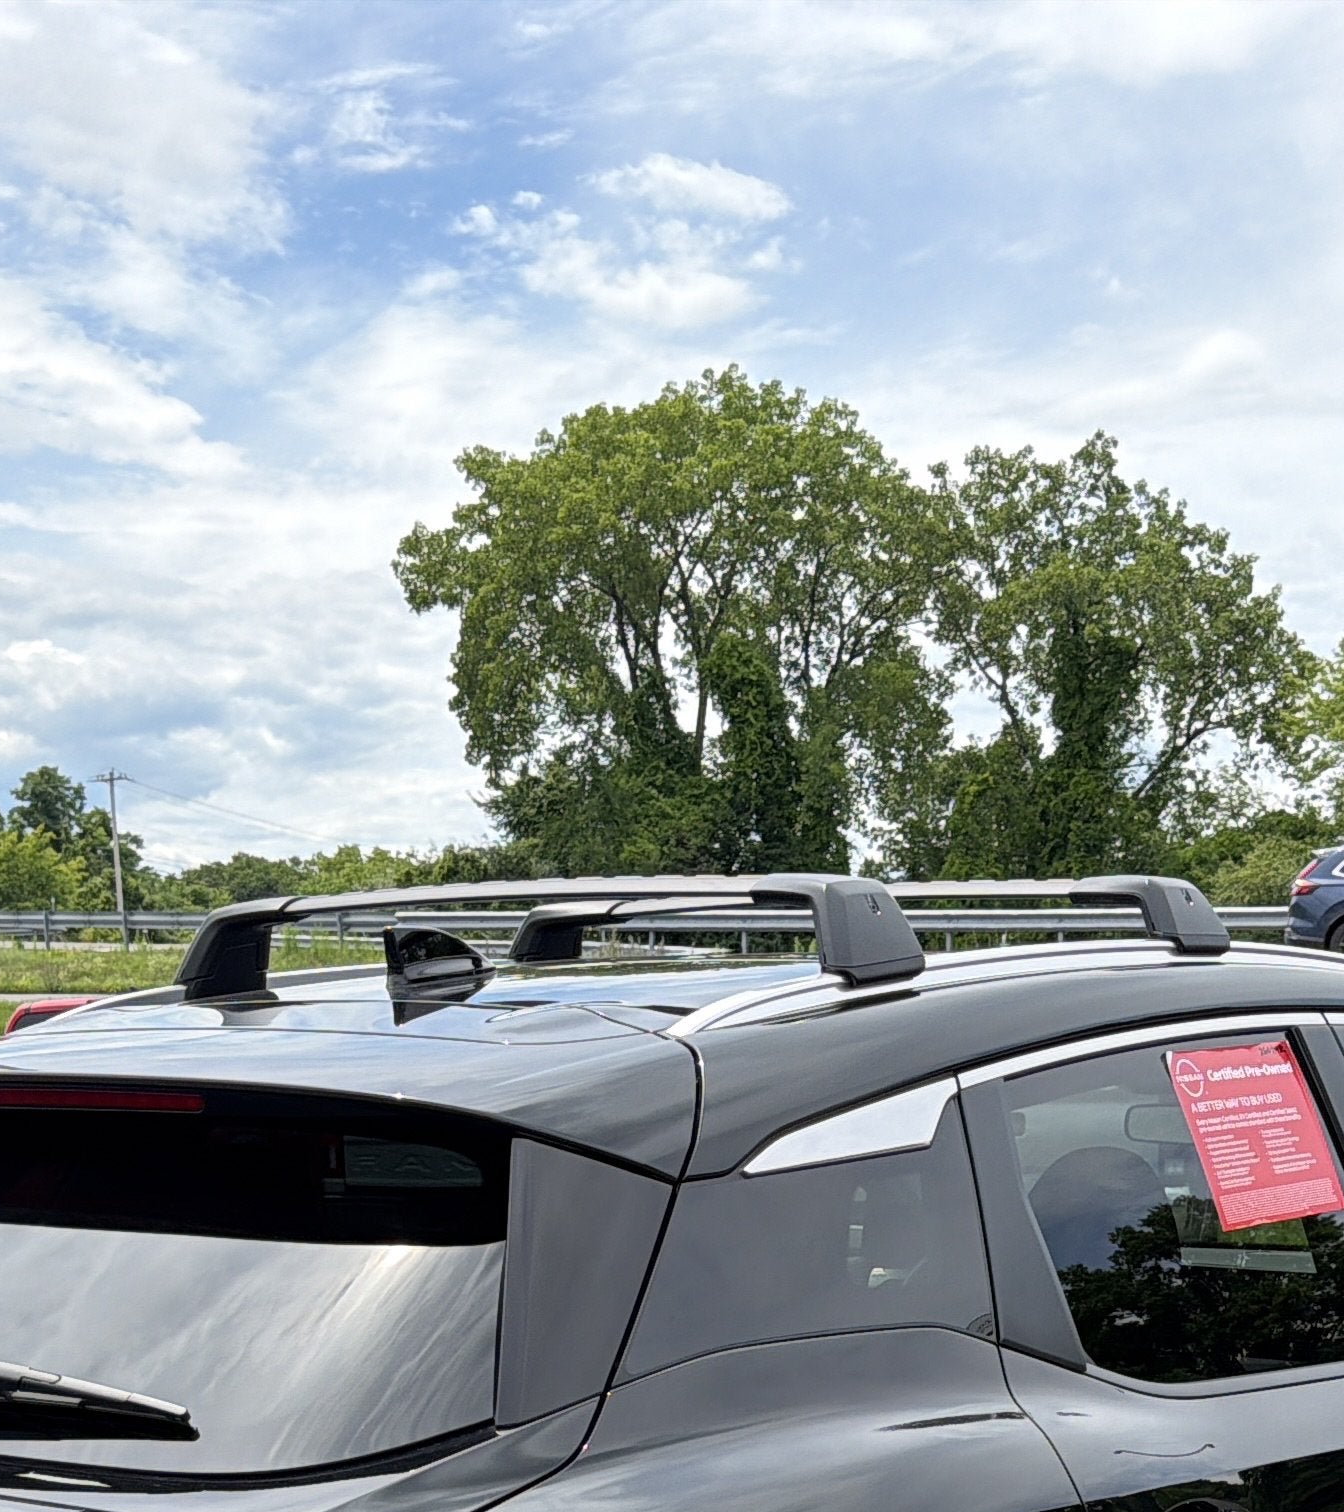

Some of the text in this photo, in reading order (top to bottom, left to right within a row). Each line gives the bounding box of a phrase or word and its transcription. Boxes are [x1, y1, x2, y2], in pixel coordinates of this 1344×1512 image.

[1207, 1062, 1293, 1081] Certified Pre-Owned
[1191, 1093, 1282, 1113] A BETTER WAY TO BUY USED
